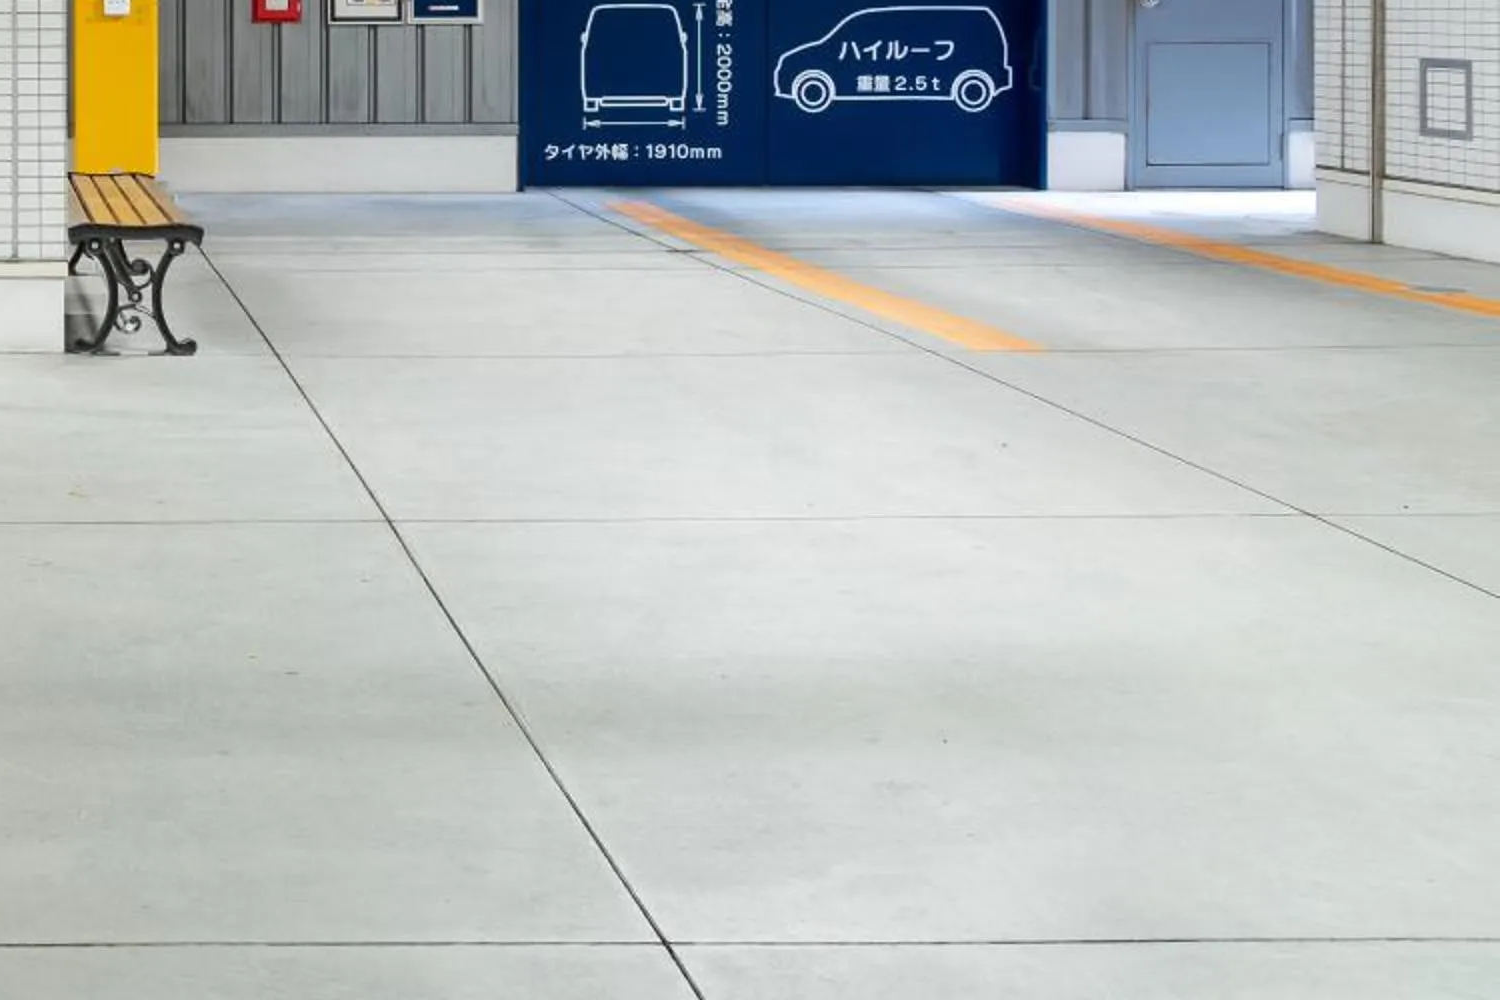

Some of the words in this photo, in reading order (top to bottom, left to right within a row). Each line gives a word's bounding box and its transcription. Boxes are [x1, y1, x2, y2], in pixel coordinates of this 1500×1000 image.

[838, 40, 955, 61] ハイルーフ
